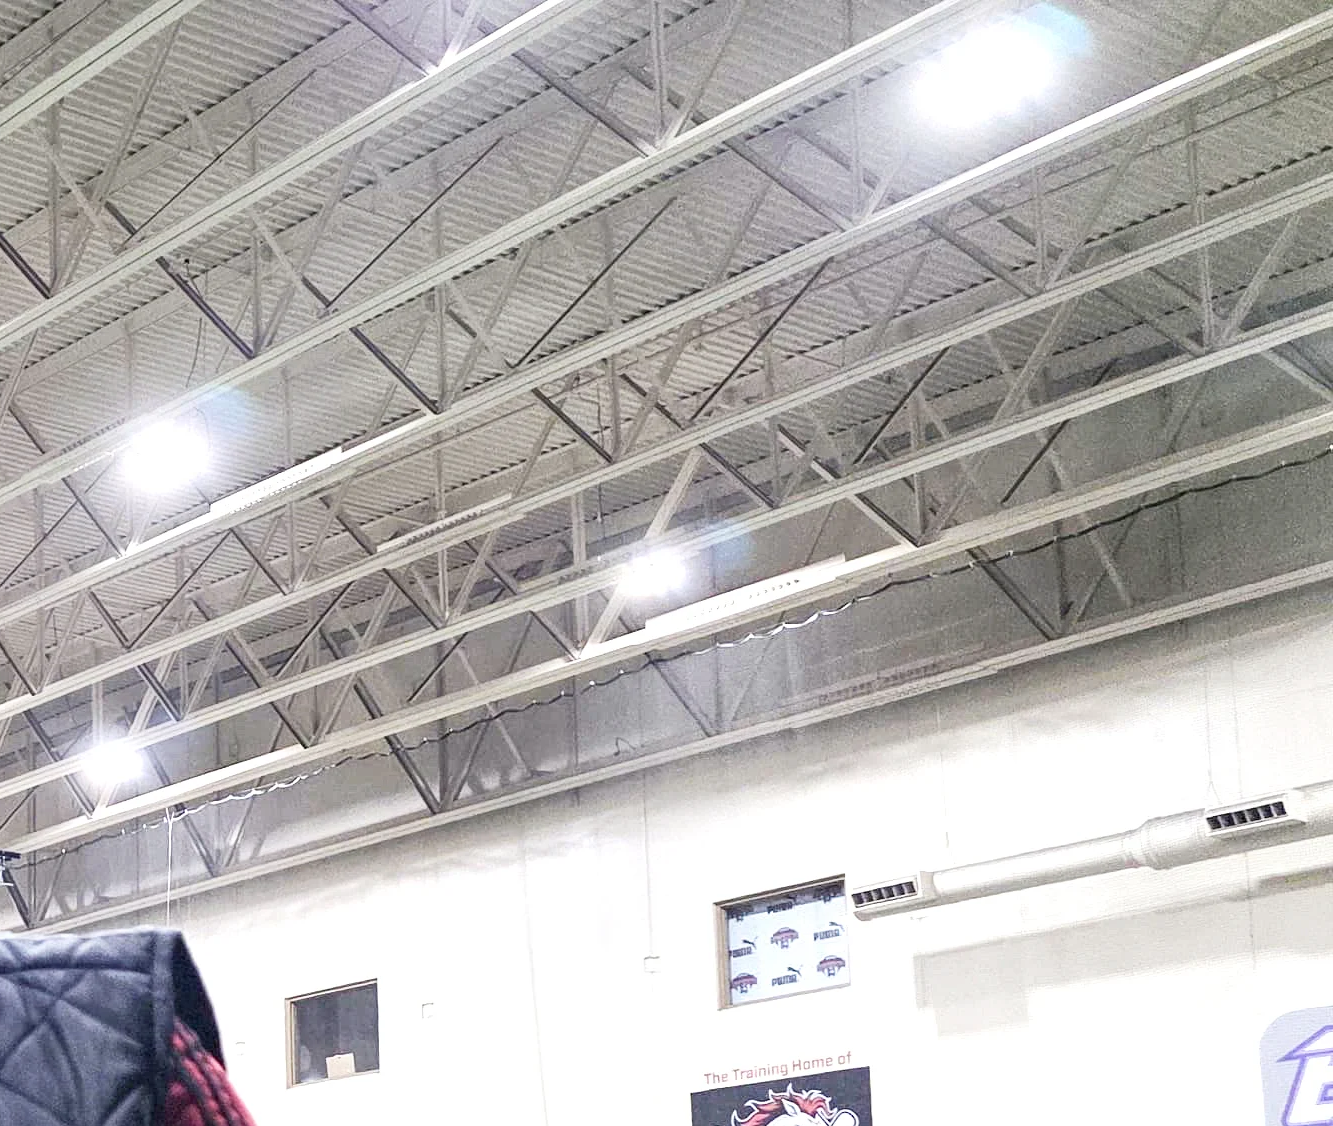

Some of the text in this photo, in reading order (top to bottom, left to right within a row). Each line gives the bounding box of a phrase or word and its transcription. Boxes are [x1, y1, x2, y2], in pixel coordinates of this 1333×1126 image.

[813, 929, 840, 941] PUMA
[771, 974, 797, 986] PUMA
[704, 1051, 852, 1084] The Training Home of
